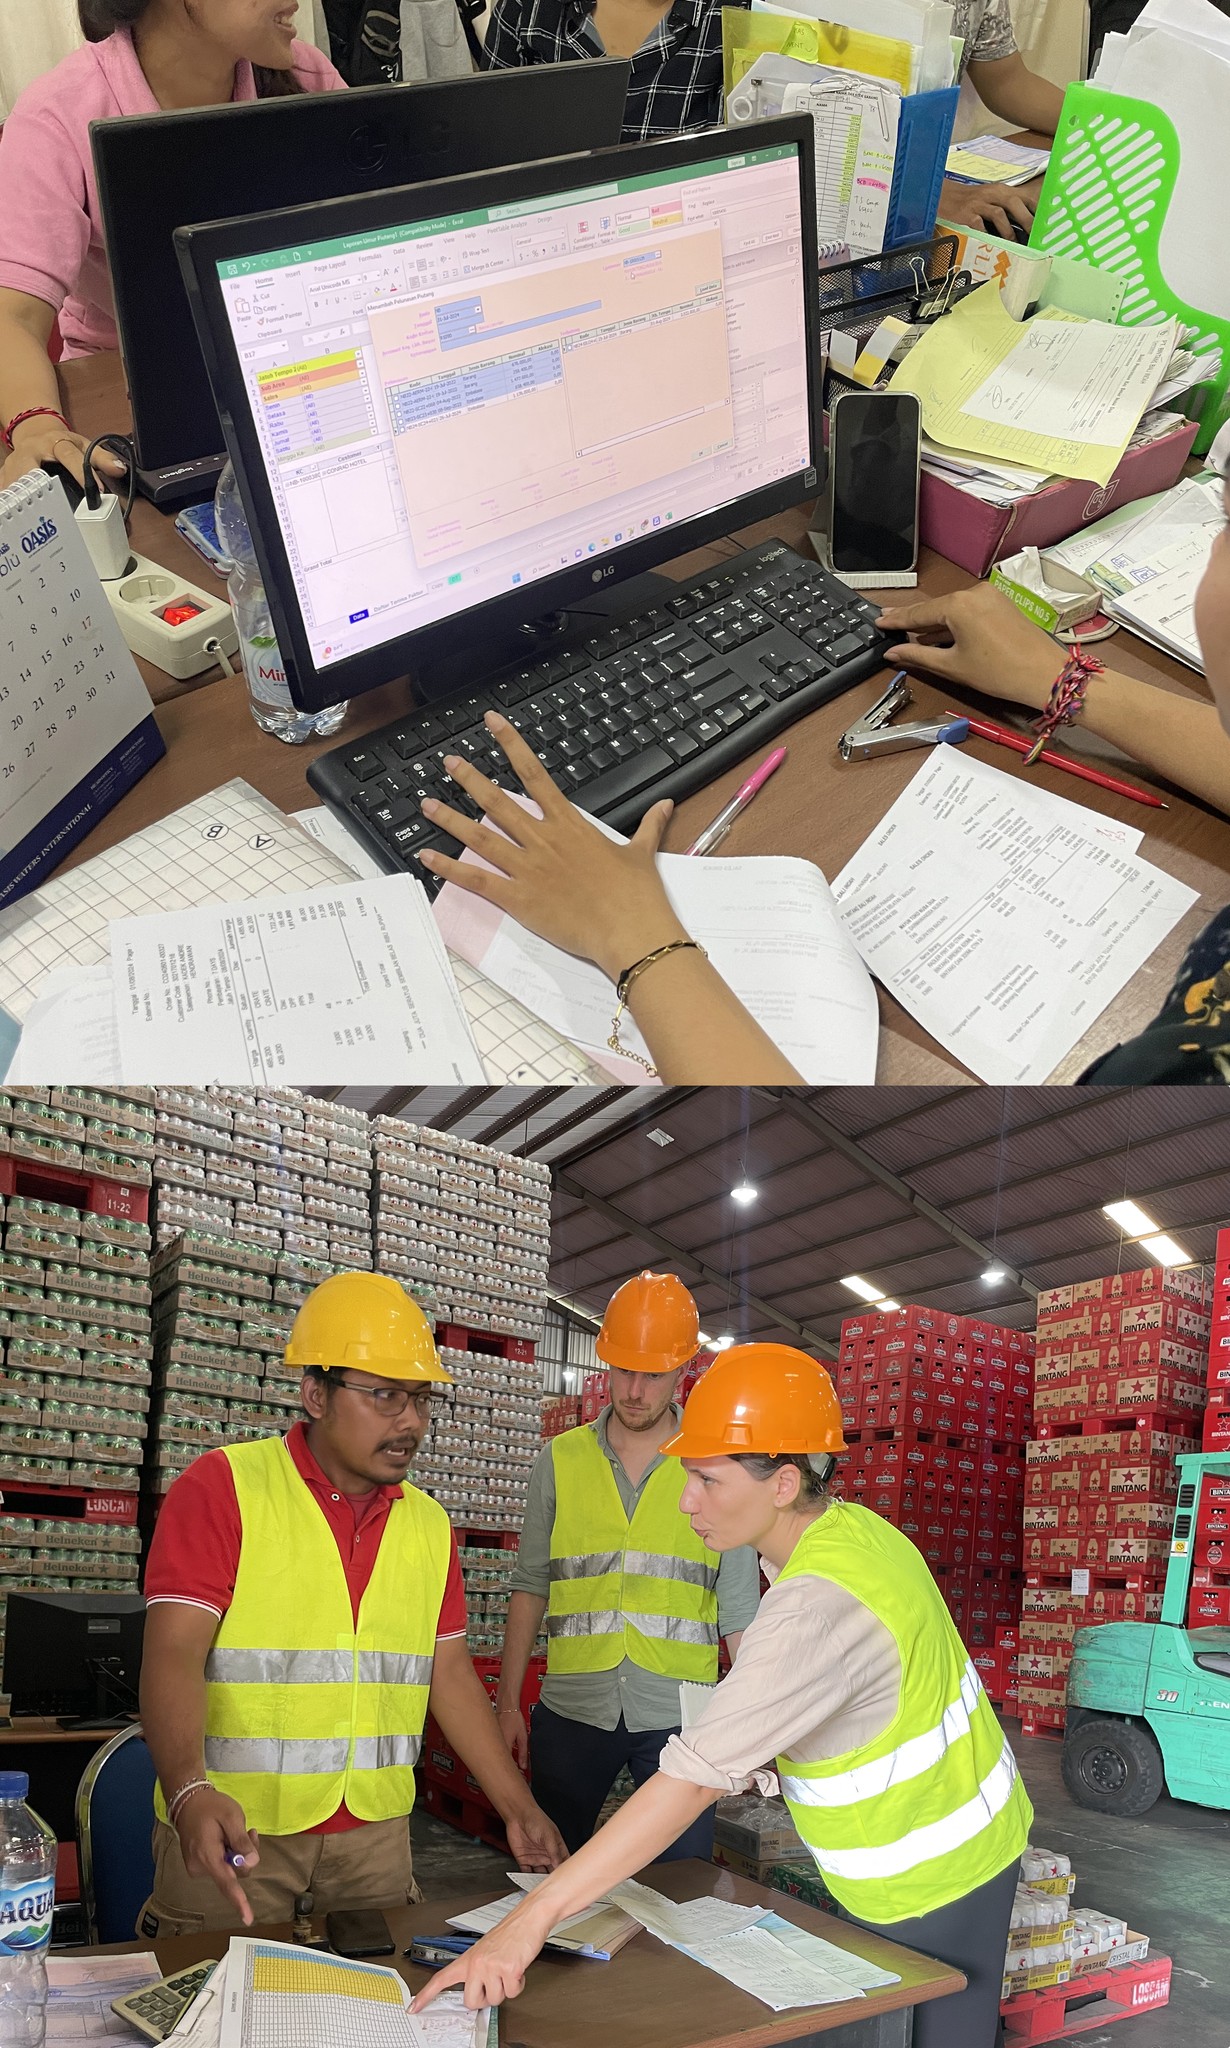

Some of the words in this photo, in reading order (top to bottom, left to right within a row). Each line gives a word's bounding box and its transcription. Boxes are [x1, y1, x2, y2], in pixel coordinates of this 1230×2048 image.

[617, 214, 632, 222] Normal
[618, 226, 631, 234] Good
[343, 240, 362, 249] Laporan
[255, 276, 273, 284] Home
[285, 270, 301, 278] Insert
[328, 260, 347, 270] Layout
[358, 253, 382, 262] Formulas
[393, 247, 405, 255] Data
[416, 241, 434, 250] Review
[443, 236, 455, 244] View
[464, 232, 477, 240] Help
[263, 304, 277, 313] Copy
[257, 328, 283, 338] Clipboard
[244, 351, 256, 359] B17
[327, 463, 350, 475] CONRAD
[349, 458, 368, 467] HOTEL
[21, 518, 57, 554] OASIS
[758, 546, 788, 563] logitech
[303, 563, 319, 572] Grand
[319, 558, 333, 568] Total
[602, 565, 615, 577] LG
[17, 594, 24, 605] 1
[38, 577, 46, 589] 2
[59, 561, 66, 573] 3
[994, 579, 1015, 600] PAPER
[1014, 592, 1035, 611] CLIPS
[7, 640, 15, 652] 7
[30, 623, 38, 635] 8
[51, 606, 58, 617] 9
[69, 588, 81, 602] 10
[353, 611, 366, 621] Data
[652, 632, 676, 646] Backspace
[19, 667, 32, 683] 14
[41, 649, 53, 665] 15
[61, 632, 73, 647] 16
[81, 615, 92, 630] 17
[11, 714, 24, 731] 20
[32, 696, 45, 712] 21
[53, 677, 66, 693] 22
[73, 660, 85, 675] 23
[92, 643, 105, 658] 24
[2, 763, 16, 779] 26
[24, 741, 36, 758] 27
[45, 722, 58, 739] 28
[65, 704, 77, 720] 29
[85, 686, 97, 702] 30
[104, 670, 116, 685] 31
[353, 753, 366, 763] Esc
[207, 825, 224, 839] B
[395, 827, 411, 837] Caps
[13, 855, 42, 885] WATERS
[41, 802, 93, 858] INTERNATIONAL
[254, 835, 273, 848] A
[252, 990, 261, 1009] CRATE
[61, 1096, 112, 1118] Heineken
[107, 1198, 131, 1214] 11-22
[191, 1243, 237, 1262] Heineken
[56, 1275, 107, 1293] Heineken
[187, 1271, 234, 1288] Heineken
[1163, 1283, 1182, 1297] BINTANG
[57, 1304, 107, 1321] Heineken
[1039, 1302, 1071, 1315] BINTANG
[1066, 1330, 1087, 1339] BINTANG
[1123, 1321, 1159, 1334] BINTANG
[180, 1350, 226, 1366] Heineken
[1036, 1370, 1068, 1382] BINTANG
[175, 1376, 222, 1391] Heineken
[53, 1386, 106, 1401] Heineken
[1119, 1393, 1155, 1405] BINTANG
[52, 1415, 104, 1430] Heineken
[1028, 1454, 1060, 1464] BINTANG
[1111, 1484, 1147, 1493] BINTANG
[1025, 1521, 1056, 1529] BINTANG
[45, 1534, 97, 1547] Heineken
[1109, 1555, 1144, 1563] BINTANG
[43, 1561, 94, 1573] Heineken
[1024, 1604, 1055, 1612] BINTANG
[1020, 1670, 1050, 1679] BINTANG
[1155, 1689, 1179, 1702] 30
[1012, 1932, 1031, 1941] BINTANG
[1082, 1959, 1107, 1973] BINTANG
[1109, 1951, 1130, 1965] CRYSTAL
